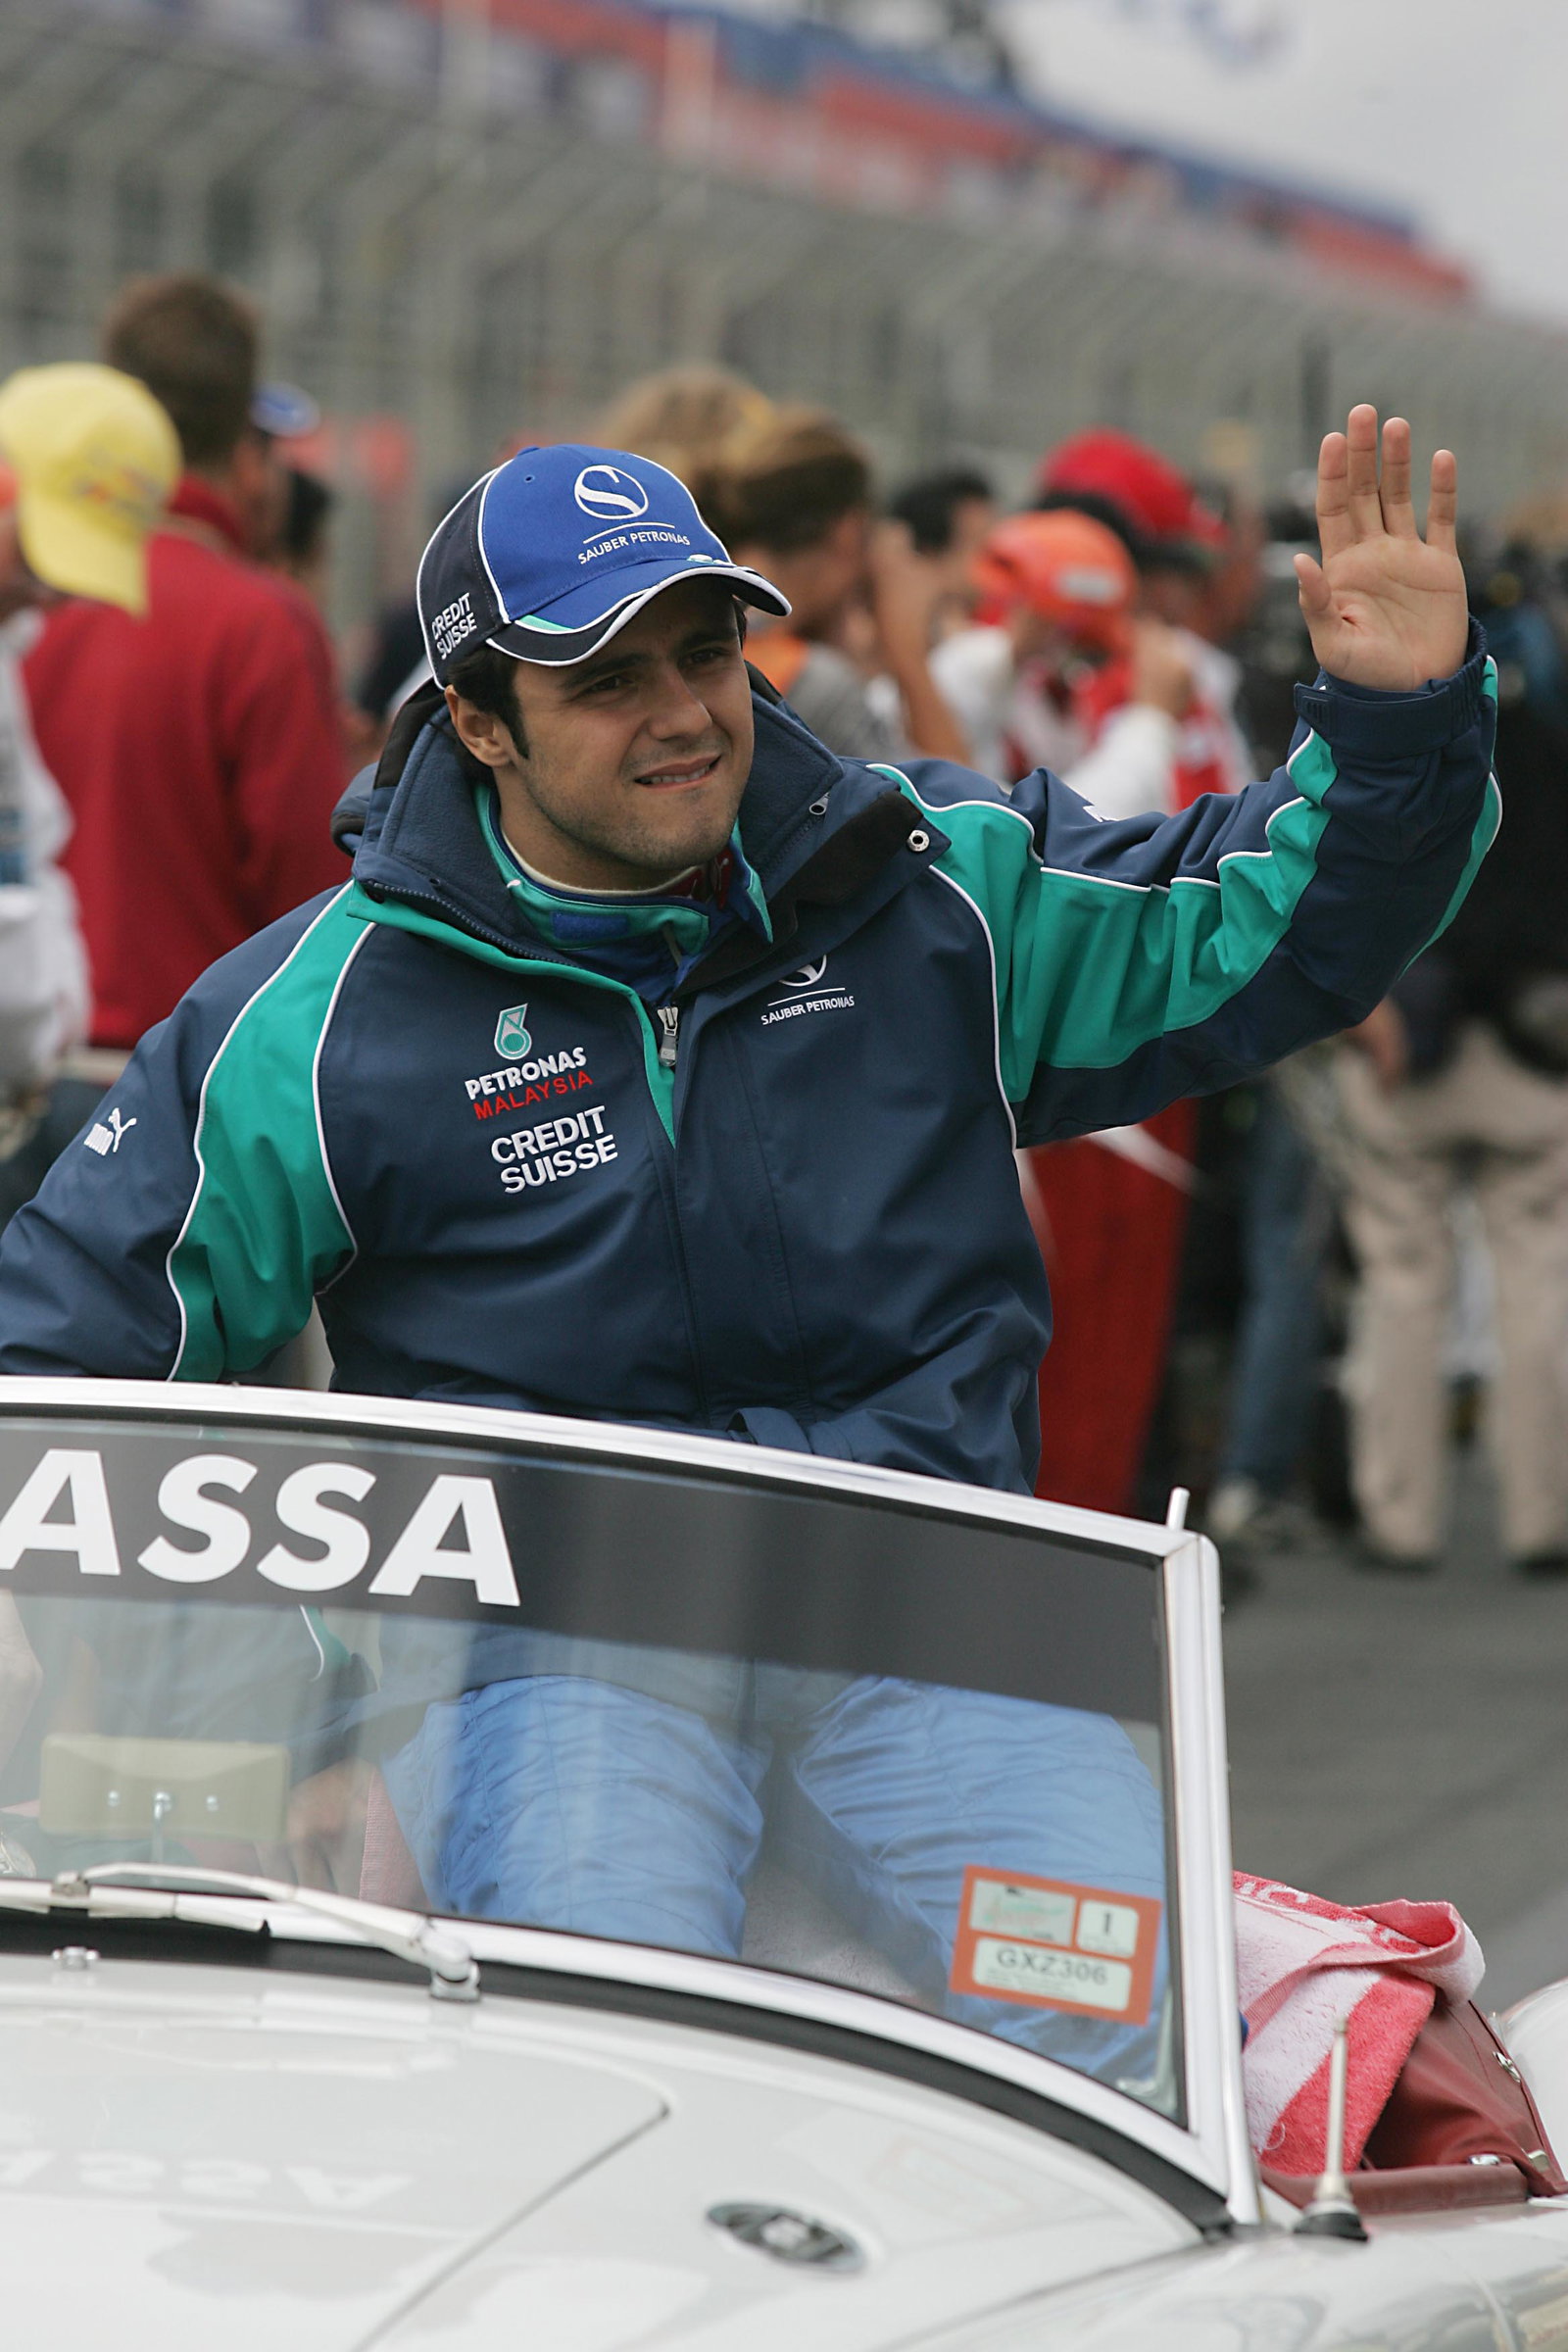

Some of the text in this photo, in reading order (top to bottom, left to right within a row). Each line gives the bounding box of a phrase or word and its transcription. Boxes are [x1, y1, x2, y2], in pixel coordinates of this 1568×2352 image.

[577, 530, 691, 565] SAUBER PETRONAS
[431, 592, 470, 641] CREDIT
[436, 612, 478, 661] SUISSE
[760, 995, 856, 1025] SAUBER PETRONAS
[464, 1046, 587, 1101] PETRONAS
[472, 1069, 594, 1121] MALAYSIA
[490, 1104, 607, 1165] CREDIT
[499, 1133, 619, 1195] SUISSE
[0, 1447, 521, 1607] ASSA
[996, 1947, 1109, 1986] GXZ306
